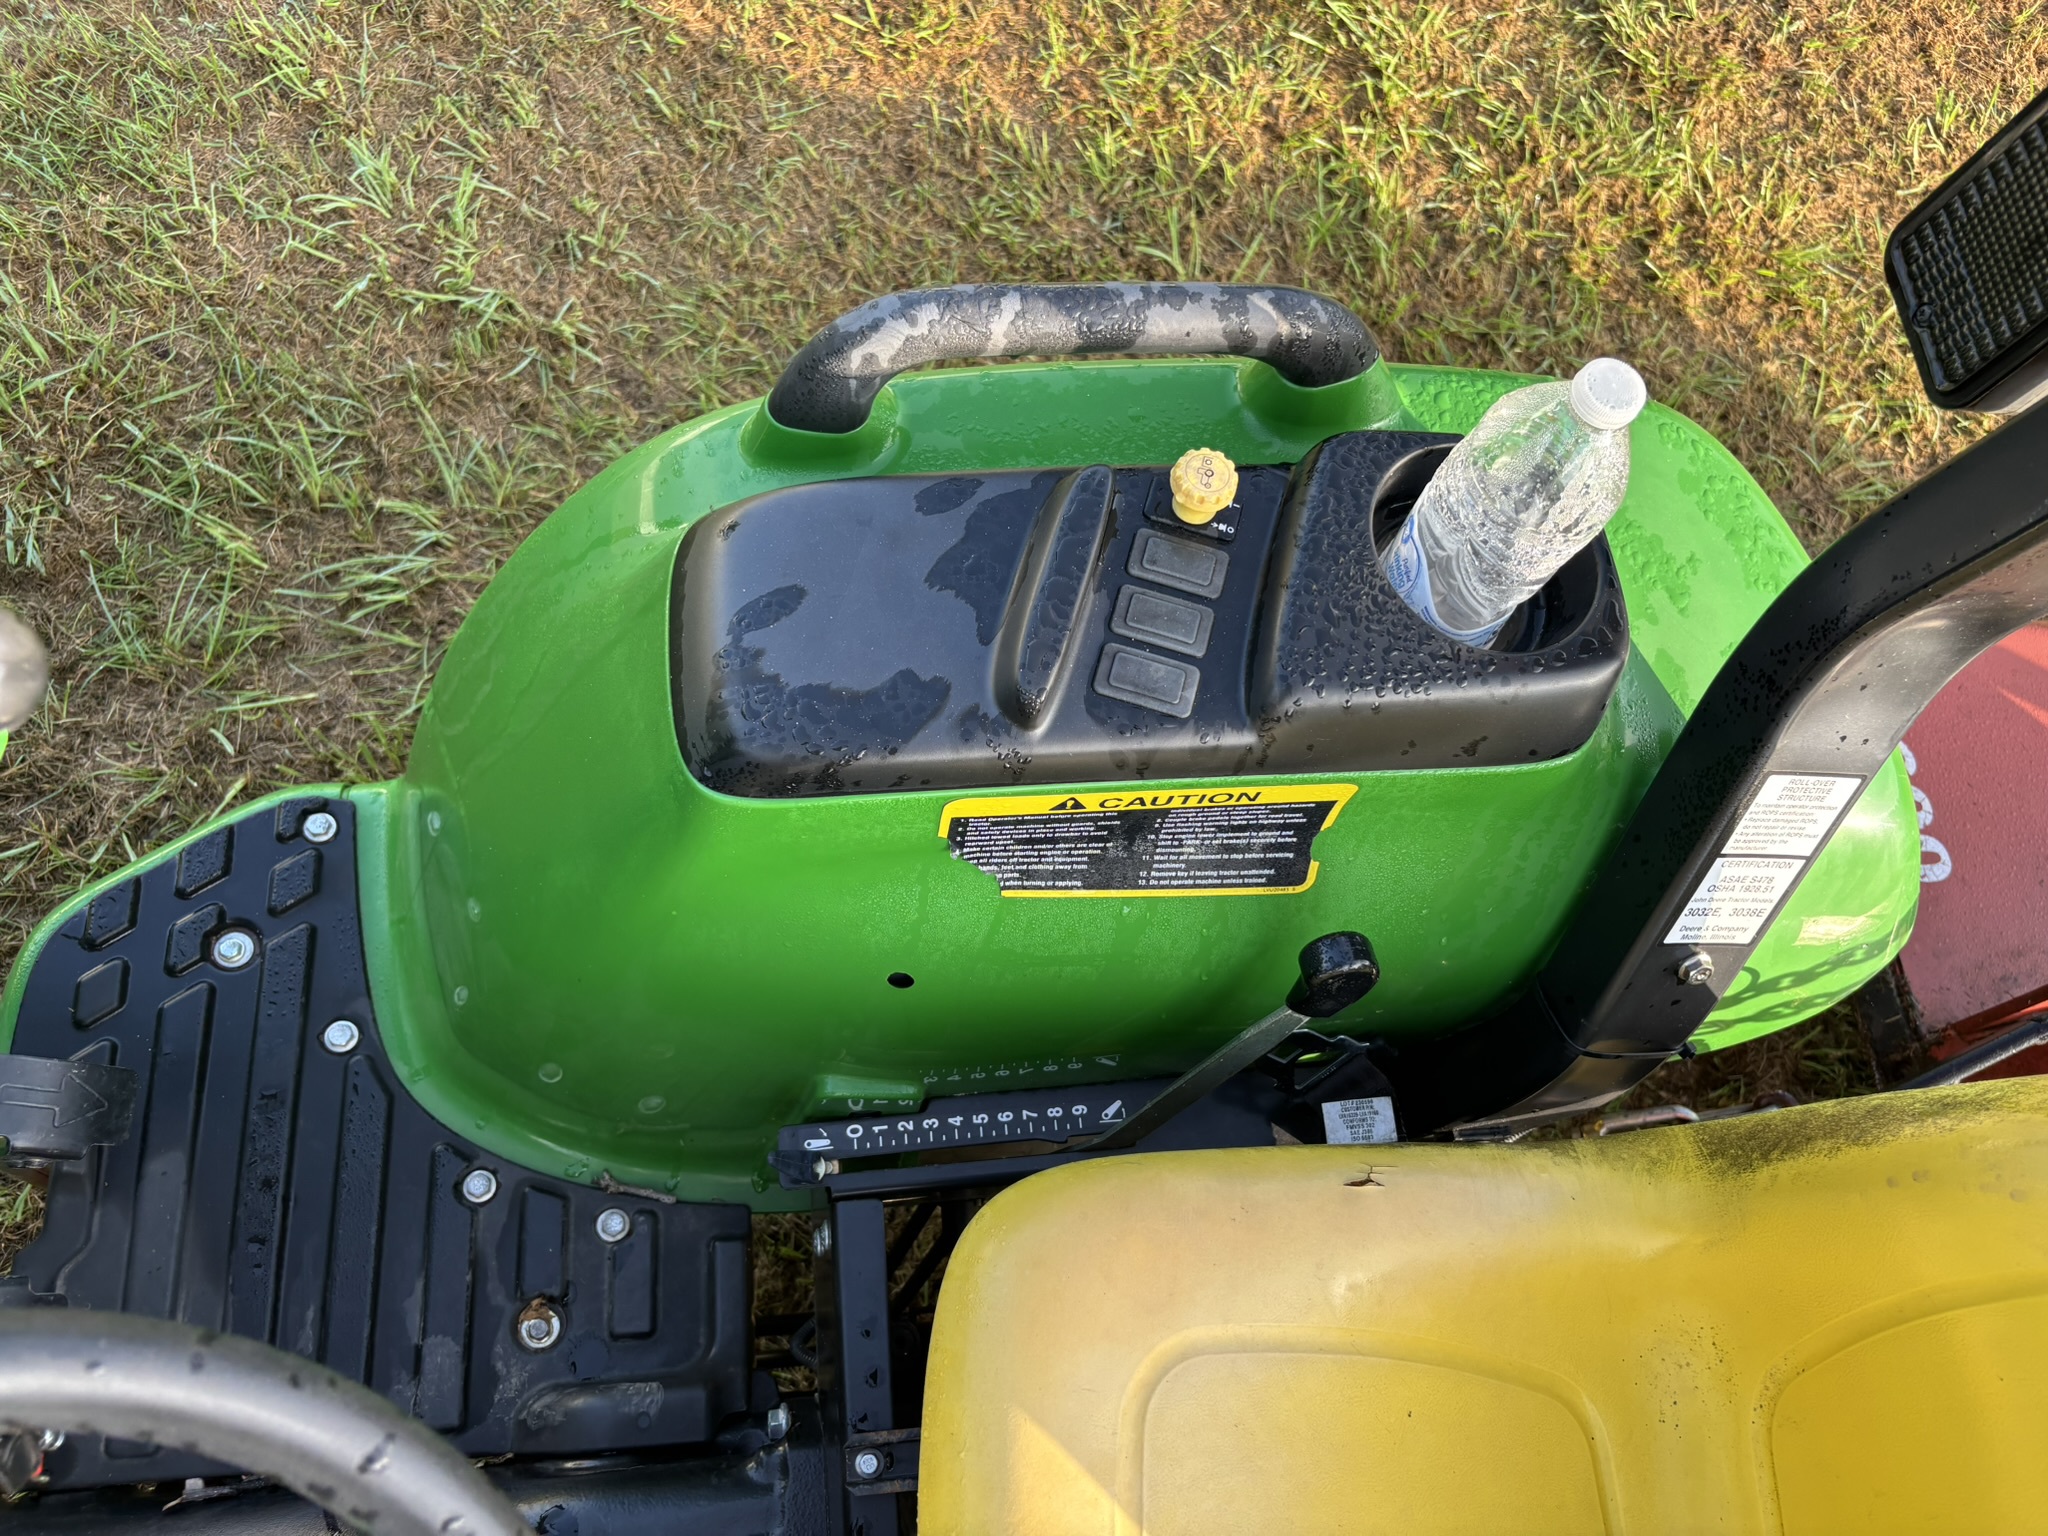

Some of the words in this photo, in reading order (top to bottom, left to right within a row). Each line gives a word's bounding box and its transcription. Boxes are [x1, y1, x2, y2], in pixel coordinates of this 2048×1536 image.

[1788, 779, 1836, 787] ROLL-OVER
[1781, 786, 1833, 795] PROTECTIVE
[1098, 791, 1262, 809] CAUTION
[1776, 794, 1827, 803] STRUCTURE
[1029, 863, 1054, 871] clothing
[1721, 860, 1794, 869] CERTIFICATION
[1719, 875, 1749, 884] ASAE
[1750, 875, 1775, 885] S478
[1707, 884, 1736, 893] OSHA
[1738, 885, 1774, 894] 1928.51
[1684, 907, 1722, 918] 3032E,
[1728, 907, 1767, 918] 3038E
[1711, 925, 1750, 934] Company
[1709, 933, 1736, 941] Illinois
[846, 1124, 863, 1138] 0
[872, 1125, 889, 1133] 1
[897, 1120, 914, 1131] 2
[922, 1118, 939, 1129] 3
[947, 1115, 964, 1126] 4
[973, 1113, 989, 1124] 5
[997, 1111, 1013, 1122] 6
[1022, 1109, 1038, 1120] 7
[1047, 1107, 1063, 1117] 8
[1072, 1104, 1088, 1115] 9
